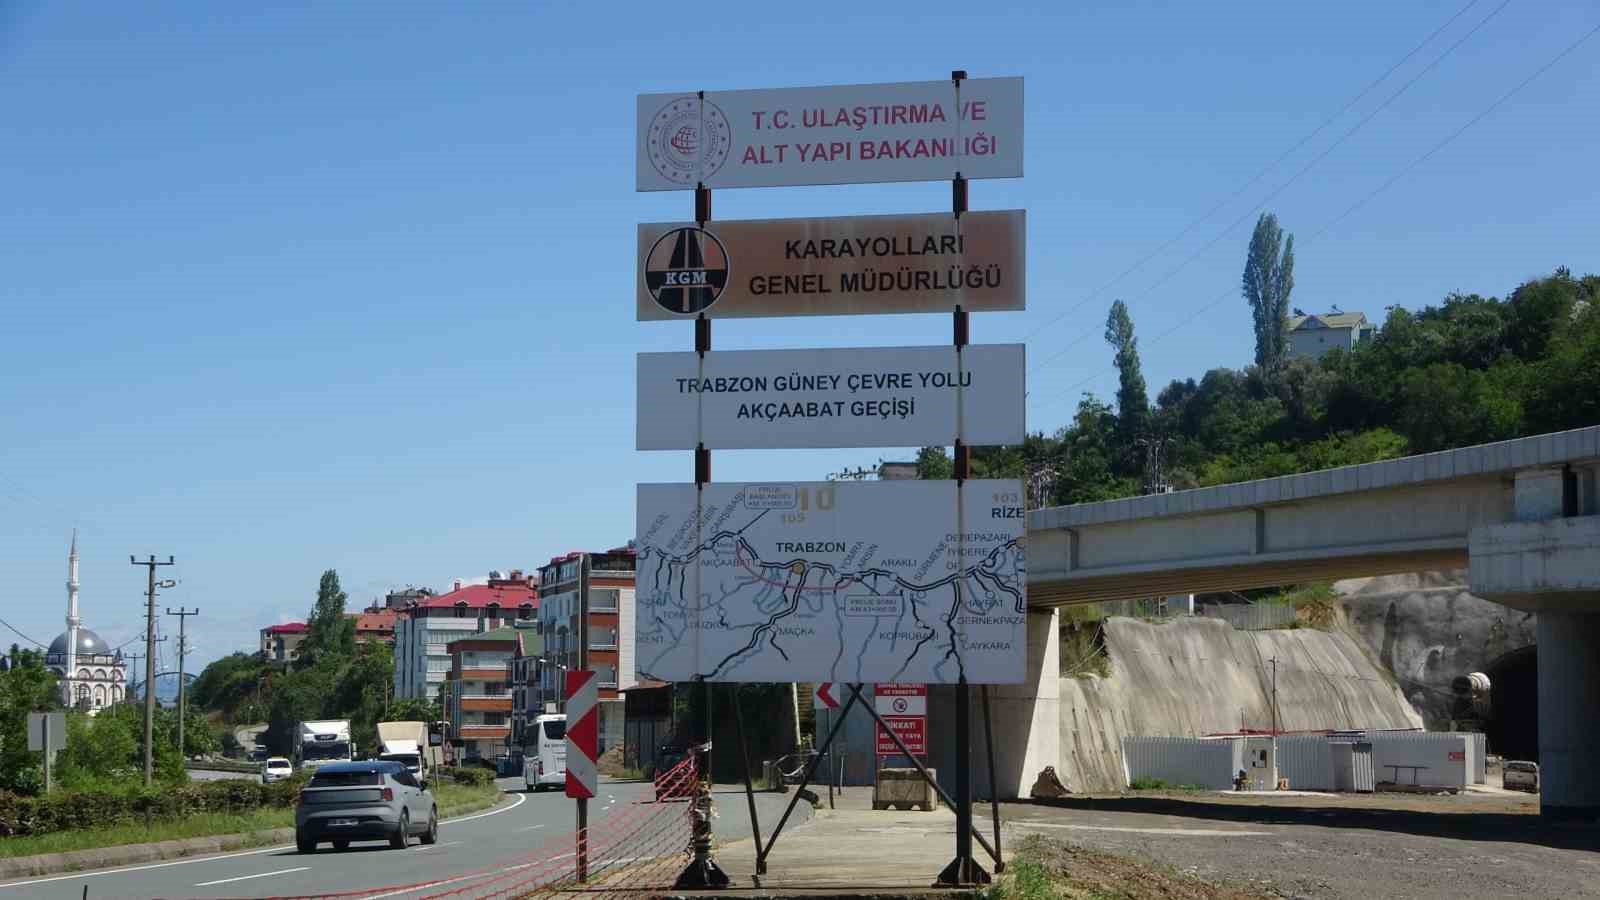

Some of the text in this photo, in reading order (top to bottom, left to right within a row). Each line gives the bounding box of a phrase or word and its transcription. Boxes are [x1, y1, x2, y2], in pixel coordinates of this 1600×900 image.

[752, 111, 795, 130] T.C.
[803, 103, 945, 131] ULAŞTIRMA
[742, 145, 787, 165] ALT
[796, 142, 851, 162] YAPI
[785, 235, 964, 259] KARAYOLLARI
[665, 271, 707, 285] KGM
[749, 264, 1002, 295] GENEL MÜDÜRLÜĞÜ
[677, 371, 972, 394] TRABZON GÜNEY ÇEVRE YOLU
[737, 396, 914, 422] AKÇAABAT GEÇİŞİ
[800, 488, 835, 511] 10
[991, 506, 1025, 518] RİZE
[776, 542, 846, 553] TRABZON
